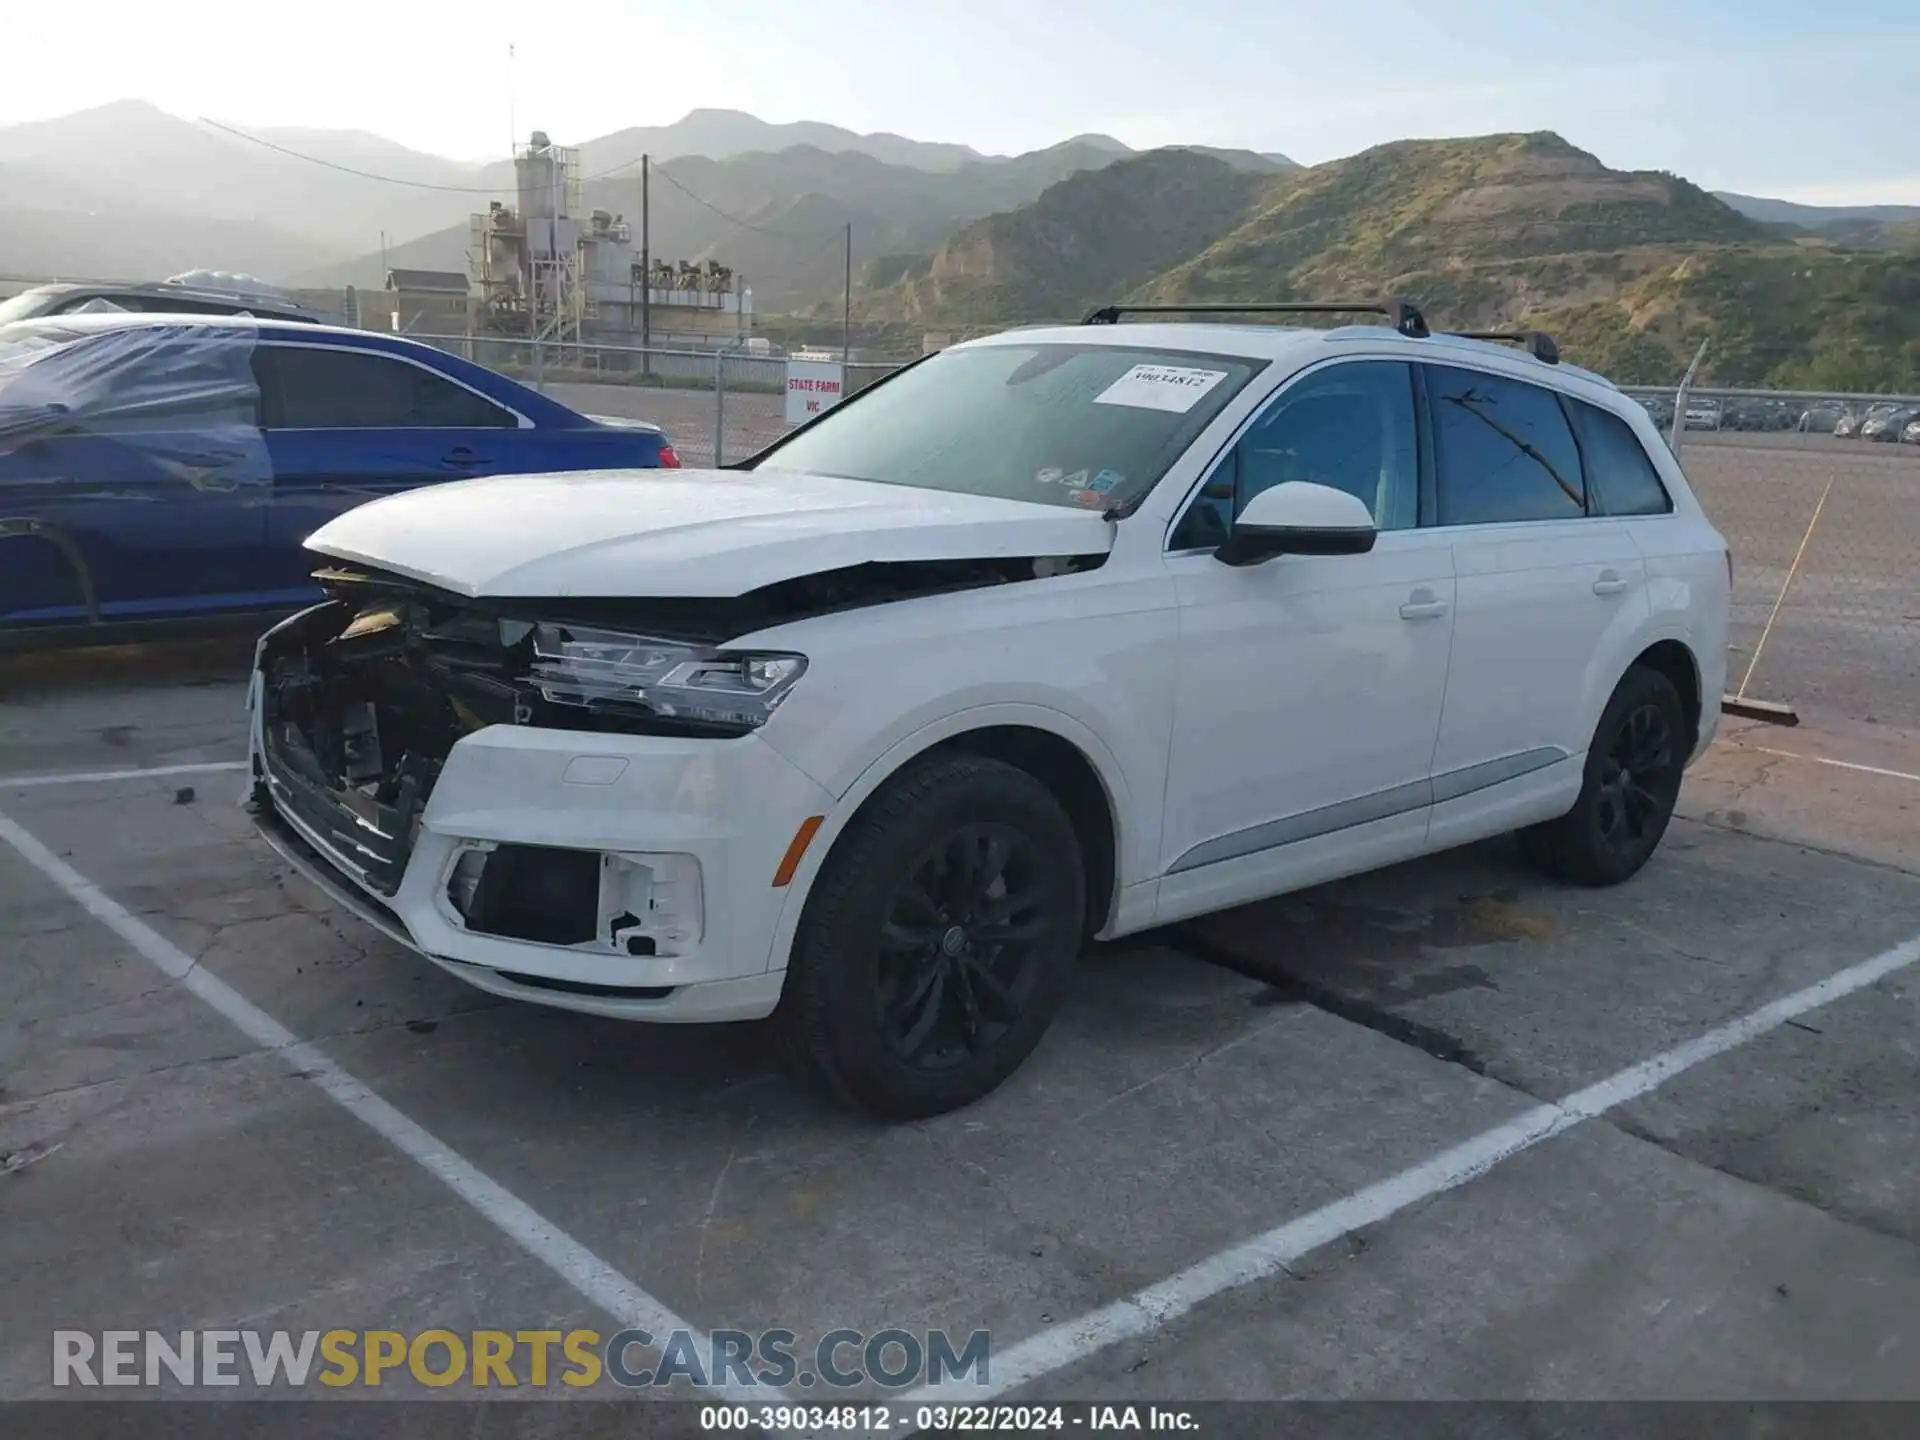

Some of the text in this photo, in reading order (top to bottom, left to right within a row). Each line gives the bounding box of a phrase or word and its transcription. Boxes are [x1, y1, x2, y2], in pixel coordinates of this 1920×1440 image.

[789, 378, 840, 393] STATE FARM
[806, 399, 820, 412] VIC
